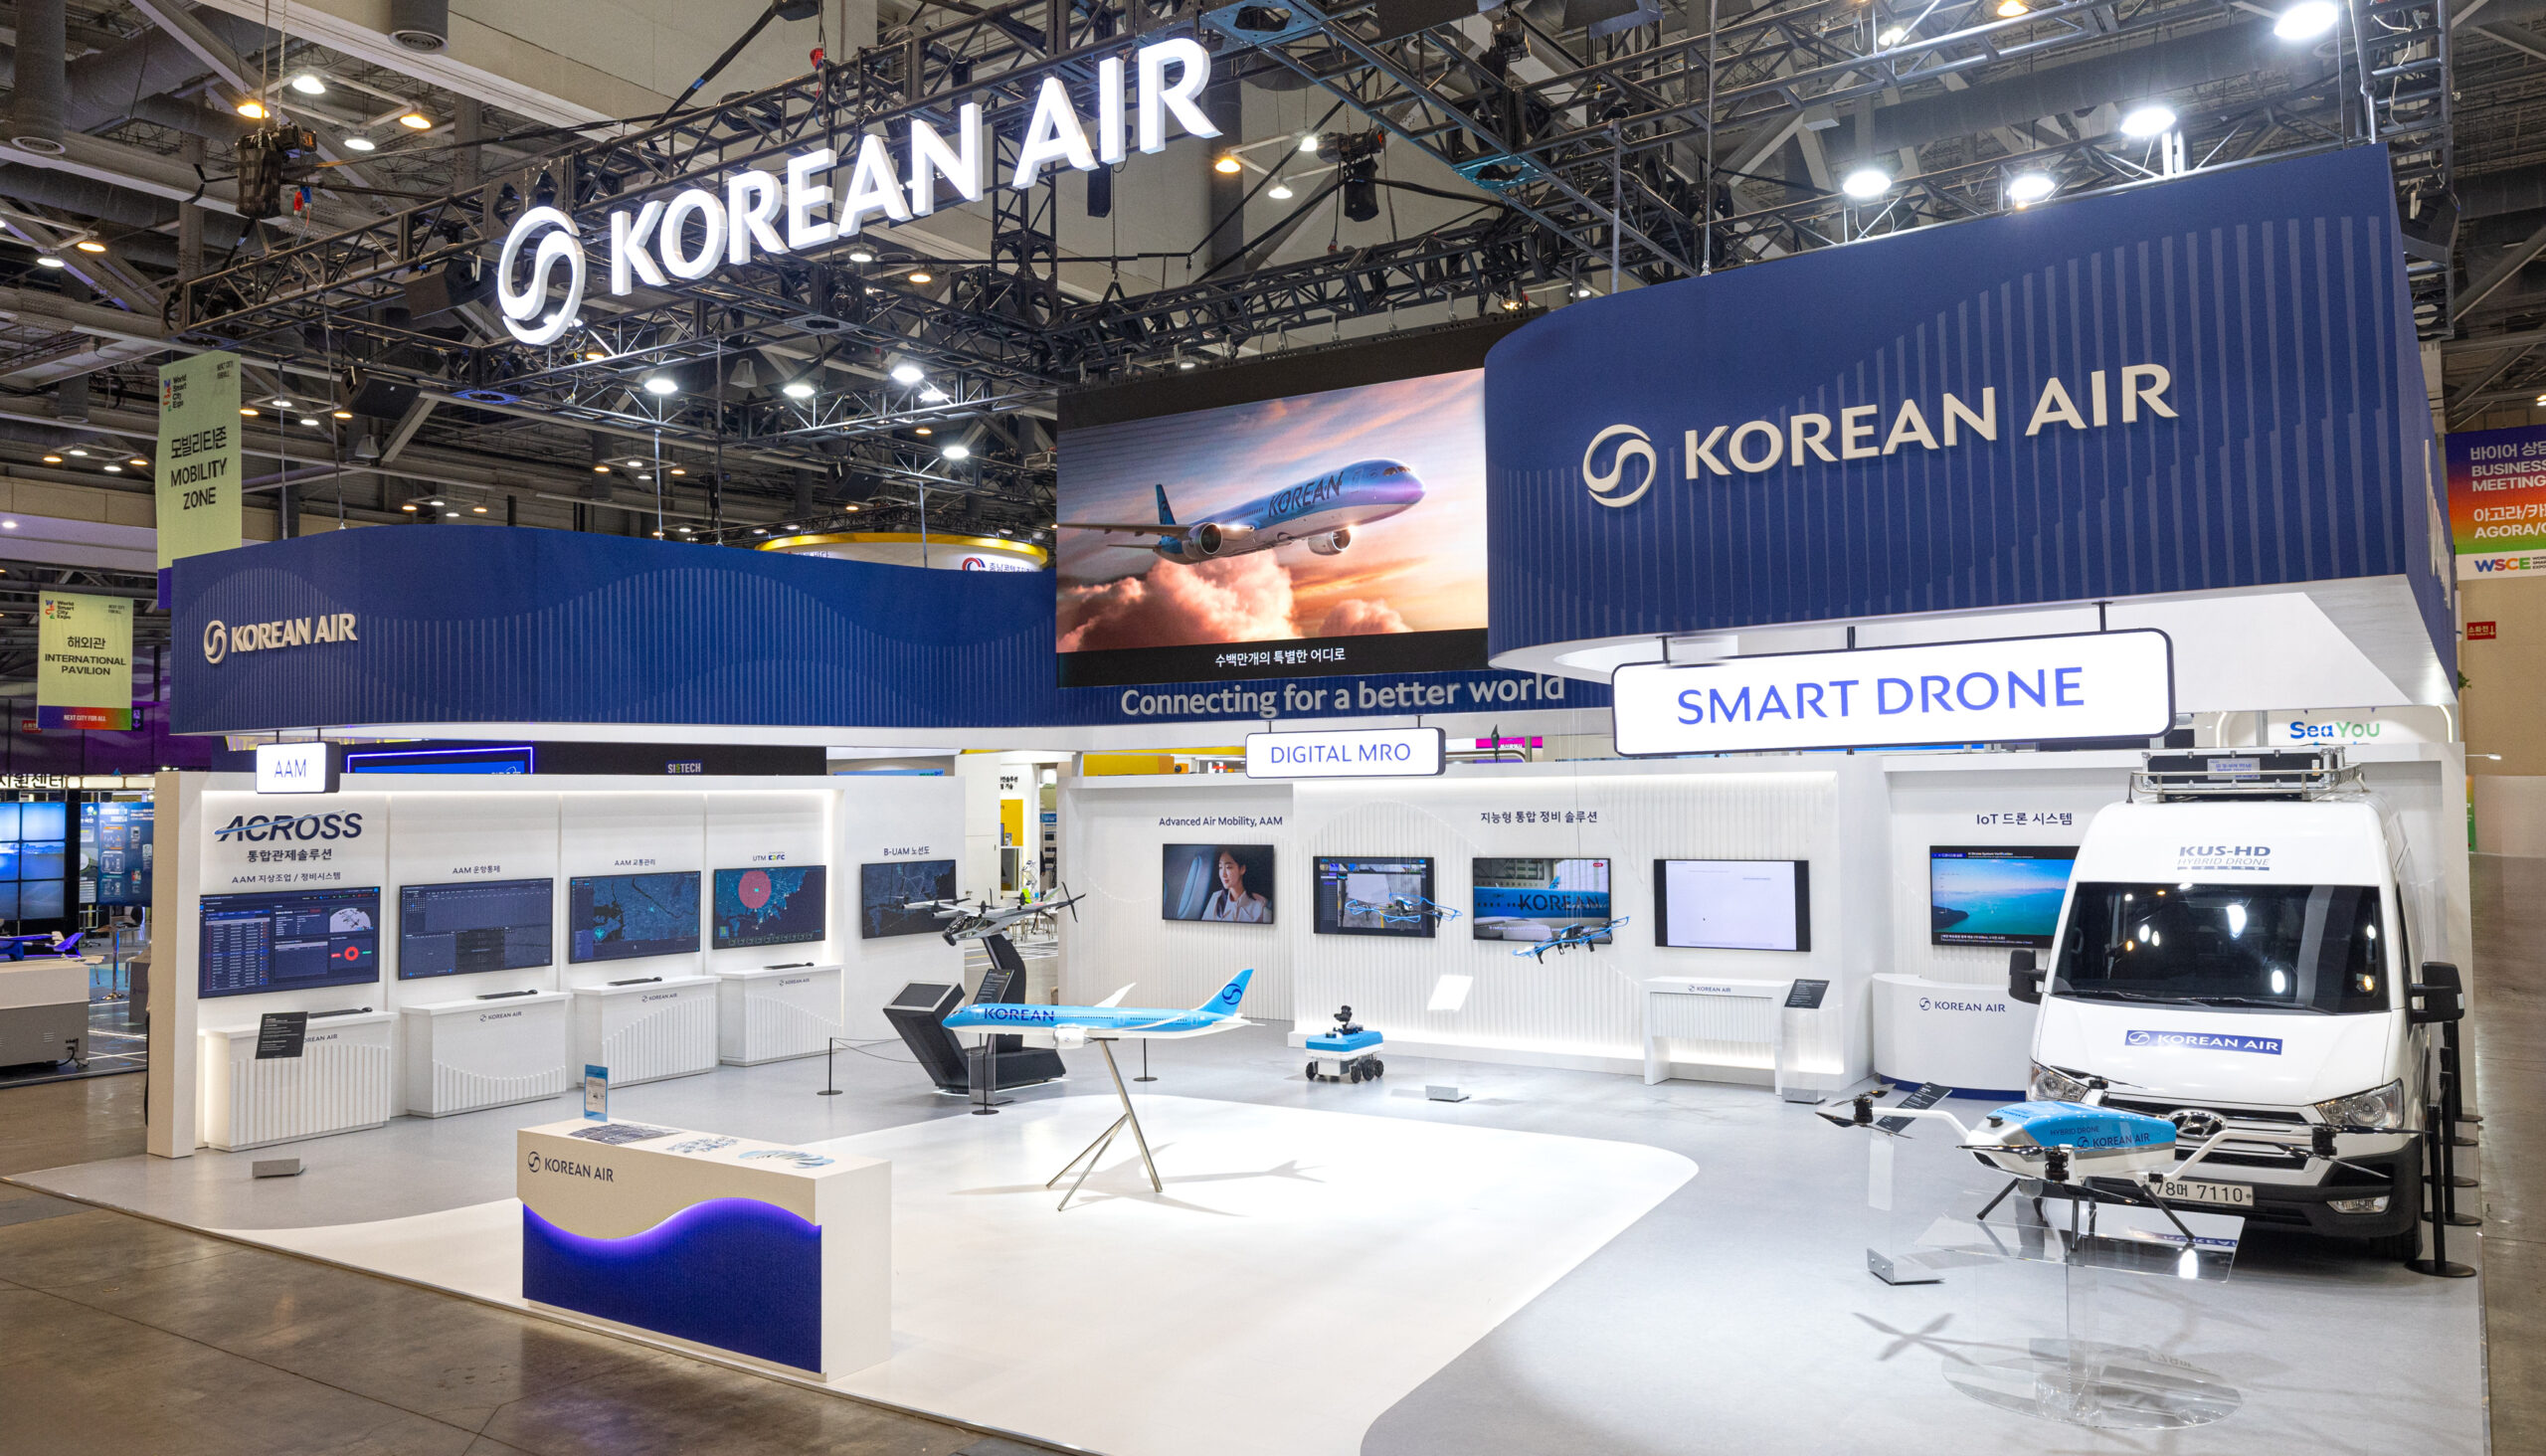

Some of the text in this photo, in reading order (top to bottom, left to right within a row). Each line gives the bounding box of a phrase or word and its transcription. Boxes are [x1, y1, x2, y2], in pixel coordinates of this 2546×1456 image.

[611, 37, 1223, 297] KOREAN AIR
[173, 374, 187, 384] World
[173, 383, 187, 392] Smart
[173, 393, 182, 401] City
[1685, 363, 2179, 480] KOREAN AIR
[171, 426, 227, 459] 모빌리티존
[2470, 443, 2517, 461] 바이어
[171, 457, 228, 487] MOBILITY
[2471, 458, 2546, 477] BUSINESS
[2472, 474, 2546, 492] MEETING
[183, 487, 216, 510] ZONE
[1268, 471, 1344, 517] KOREAN
[2473, 504, 2546, 522] 아고라/카
[2474, 557, 2531, 573] WSCE
[231, 613, 358, 653] KOREAN AIR
[67, 636, 106, 650] 해외관
[45, 654, 126, 666] INTERNATIONAL
[1215, 646, 1346, 668] 수백만개의 특별한 어디로
[61, 666, 111, 675] PAVILION
[1121, 673, 1565, 719] Connecting for a better world
[1678, 667, 2085, 725] SMART DRONE
[2290, 721, 2380, 739] SeaYou
[1271, 743, 1412, 764] DIGITAL MRO
[274, 759, 307, 778] AAM
[1159, 816, 1283, 827] Advanced Air Mobility, AAM
[1480, 811, 1597, 824] 지능형 통합 정비 솔루션
[1976, 813, 2073, 825] IoT 드론 시스템
[217, 813, 363, 842] ACROSS
[247, 848, 332, 862] 통합관제솔루션
[883, 846, 930, 856] B-UAM 노선도
[2179, 846, 2271, 856] KUS-HD
[2177, 857, 2269, 866] HYBRID DRONE
[258, 874, 291, 882] 지상조업
[301, 872, 341, 881] 정비시스템
[1520, 894, 1599, 910] KOREAN
[985, 1007, 1054, 1022] KOREAN
[1935, 1001, 2005, 1012] KOREAN AIR
[2158, 1035, 2278, 1051] KOREAN AIR
[2077, 1126, 2100, 1134] DRONE
[2093, 1133, 2150, 1147] KOREAN AIR
[545, 1157, 614, 1182] KOREAN AIR
[2155, 1181, 2242, 1202] 78머 7110
